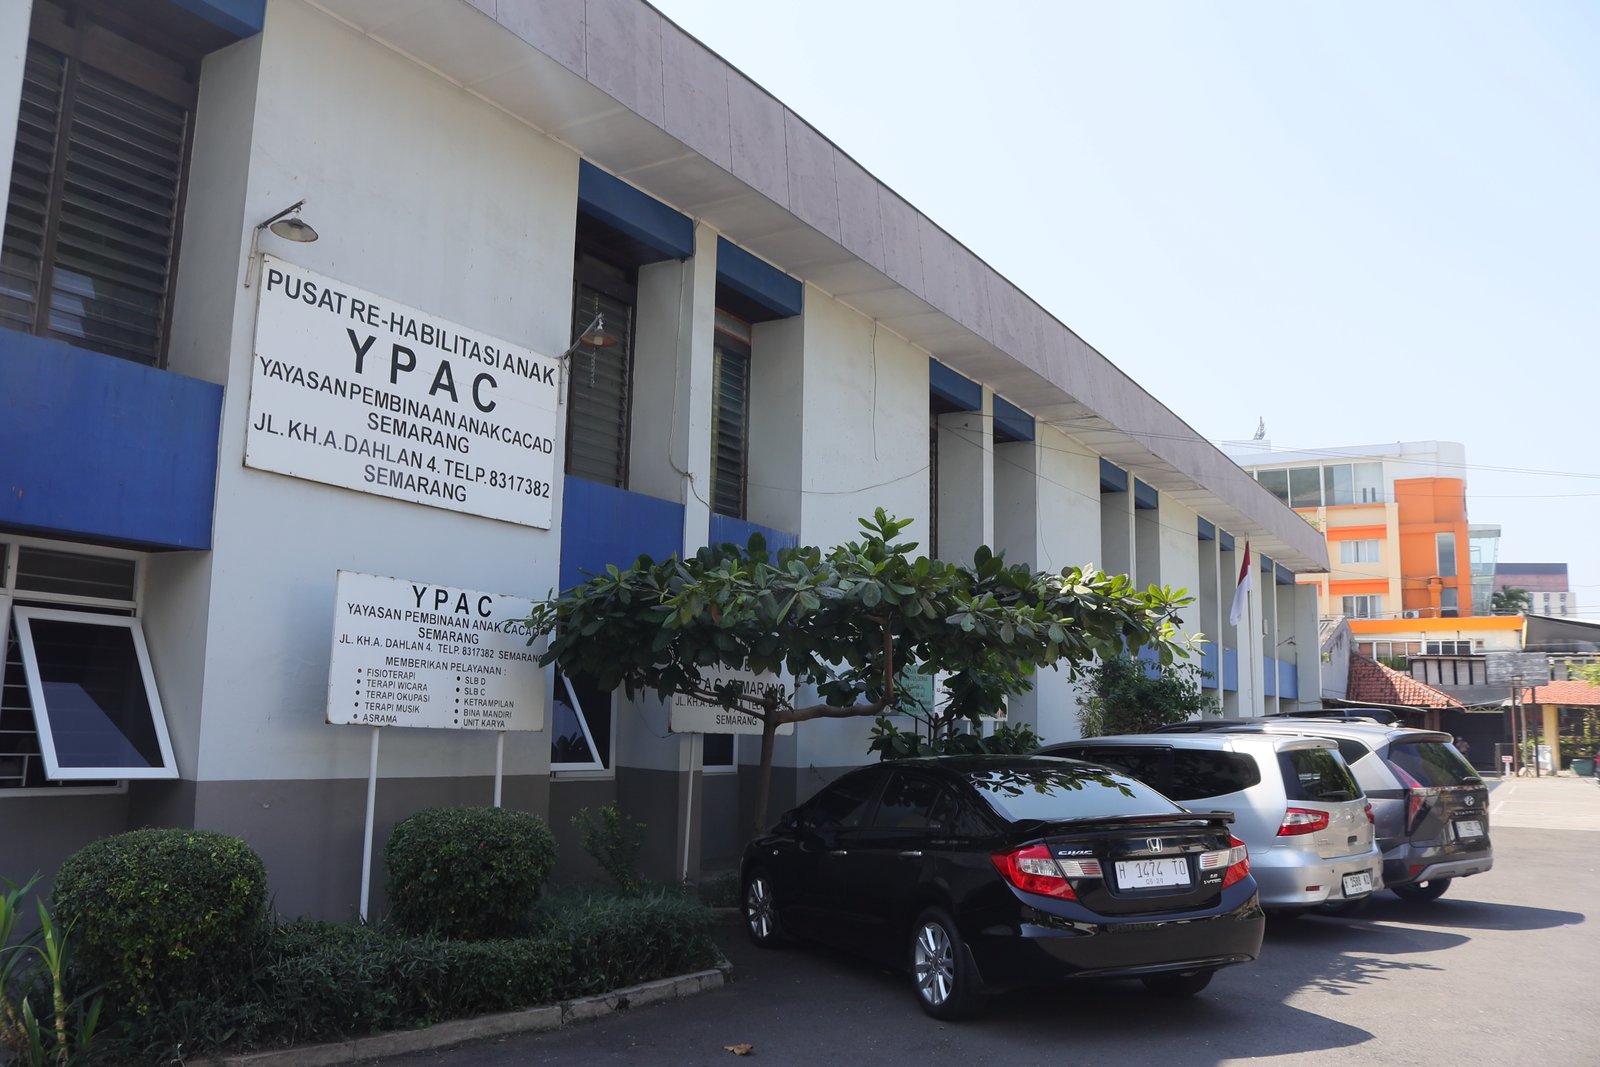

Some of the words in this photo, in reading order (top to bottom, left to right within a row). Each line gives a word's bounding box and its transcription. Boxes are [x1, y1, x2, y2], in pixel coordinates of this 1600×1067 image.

[267, 268, 347, 315] PUSAT
[350, 298, 501, 368] RE-HABILITASI
[502, 353, 555, 387] ANAK
[259, 356, 346, 397] YAYASAN
[349, 384, 455, 428] PEMBINAAN
[458, 415, 500, 441] ANAK
[502, 425, 553, 455] CACAD
[367, 412, 469, 454] SEMARANG
[364, 464, 467, 502] SEMARANG
[347, 602, 402, 621] YAYASAN
[404, 610, 469, 629] PEMBINAAN
[472, 620, 501, 632] ANAK
[418, 627, 479, 644] SEMARANG
[339, 634, 354, 645] JL.
[385, 638, 424, 651] DAHLAN
[438, 644, 460, 655] TELP.
[462, 646, 494, 658] 8317382
[385, 656, 448, 670] MEMBERIKAN
[450, 662, 502, 675] PELAYANAN
[366, 668, 415, 680] FISIOTERAPI
[366, 679, 395, 688] TERAPI
[397, 682, 428, 691] WICARA
[465, 676, 479, 685] SLB
[480, 677, 486, 685] D
[366, 690, 394, 700] TERAPI
[396, 692, 430, 702] OKUPASI
[464, 687, 479, 696] SLB
[480, 688, 486, 696] C
[365, 702, 393, 711] TERAPI
[395, 704, 420, 713] MUSIK
[463, 698, 514, 708] KETRAMPILAN
[362, 713, 397, 723] ASRAMA
[463, 708, 480, 717] BINA
[482, 710, 512, 718] MANDIRI
[463, 718, 479, 727] UNIT
[481, 719, 505, 728] KARYA
[716, 714, 758, 726] SEMARANG
[1118, 864, 1126, 879] H
[1135, 862, 1163, 878] 1474
